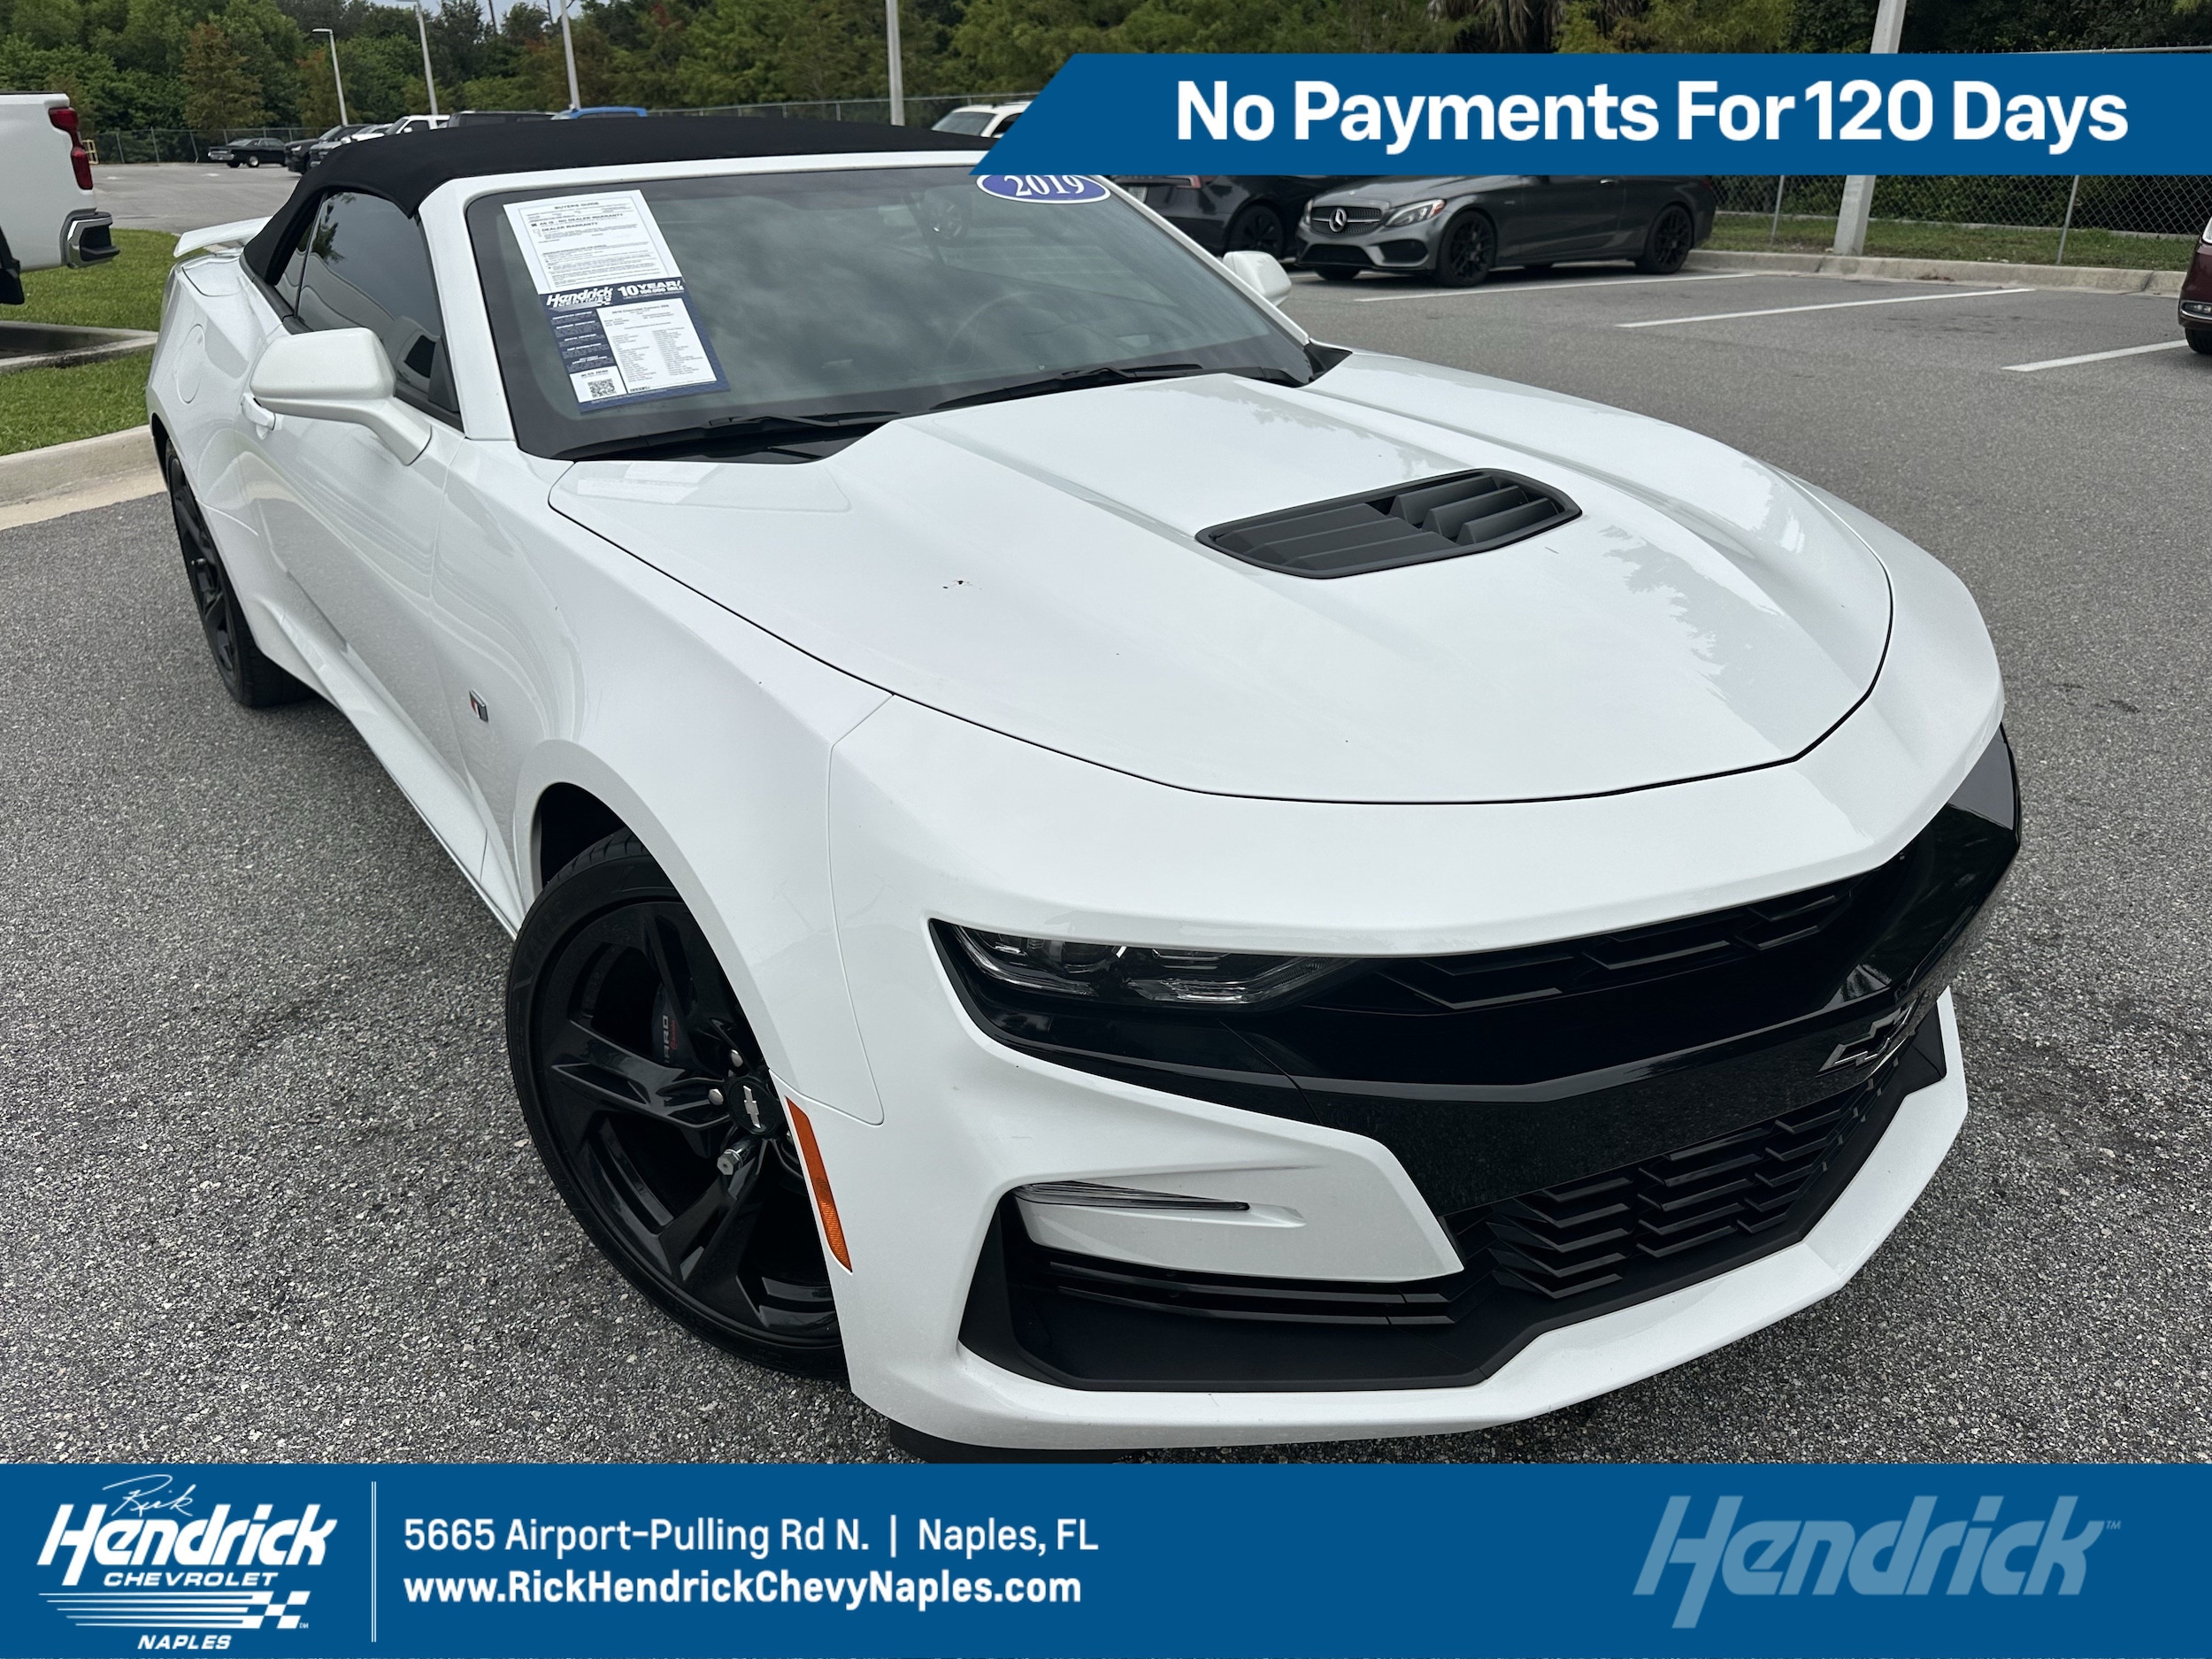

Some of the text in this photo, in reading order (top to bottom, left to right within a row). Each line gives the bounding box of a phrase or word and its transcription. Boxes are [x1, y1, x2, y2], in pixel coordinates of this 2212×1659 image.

[1003, 174, 1086, 197] 2019
[546, 286, 614, 308] Hendrick
[617, 284, 640, 297] 10
